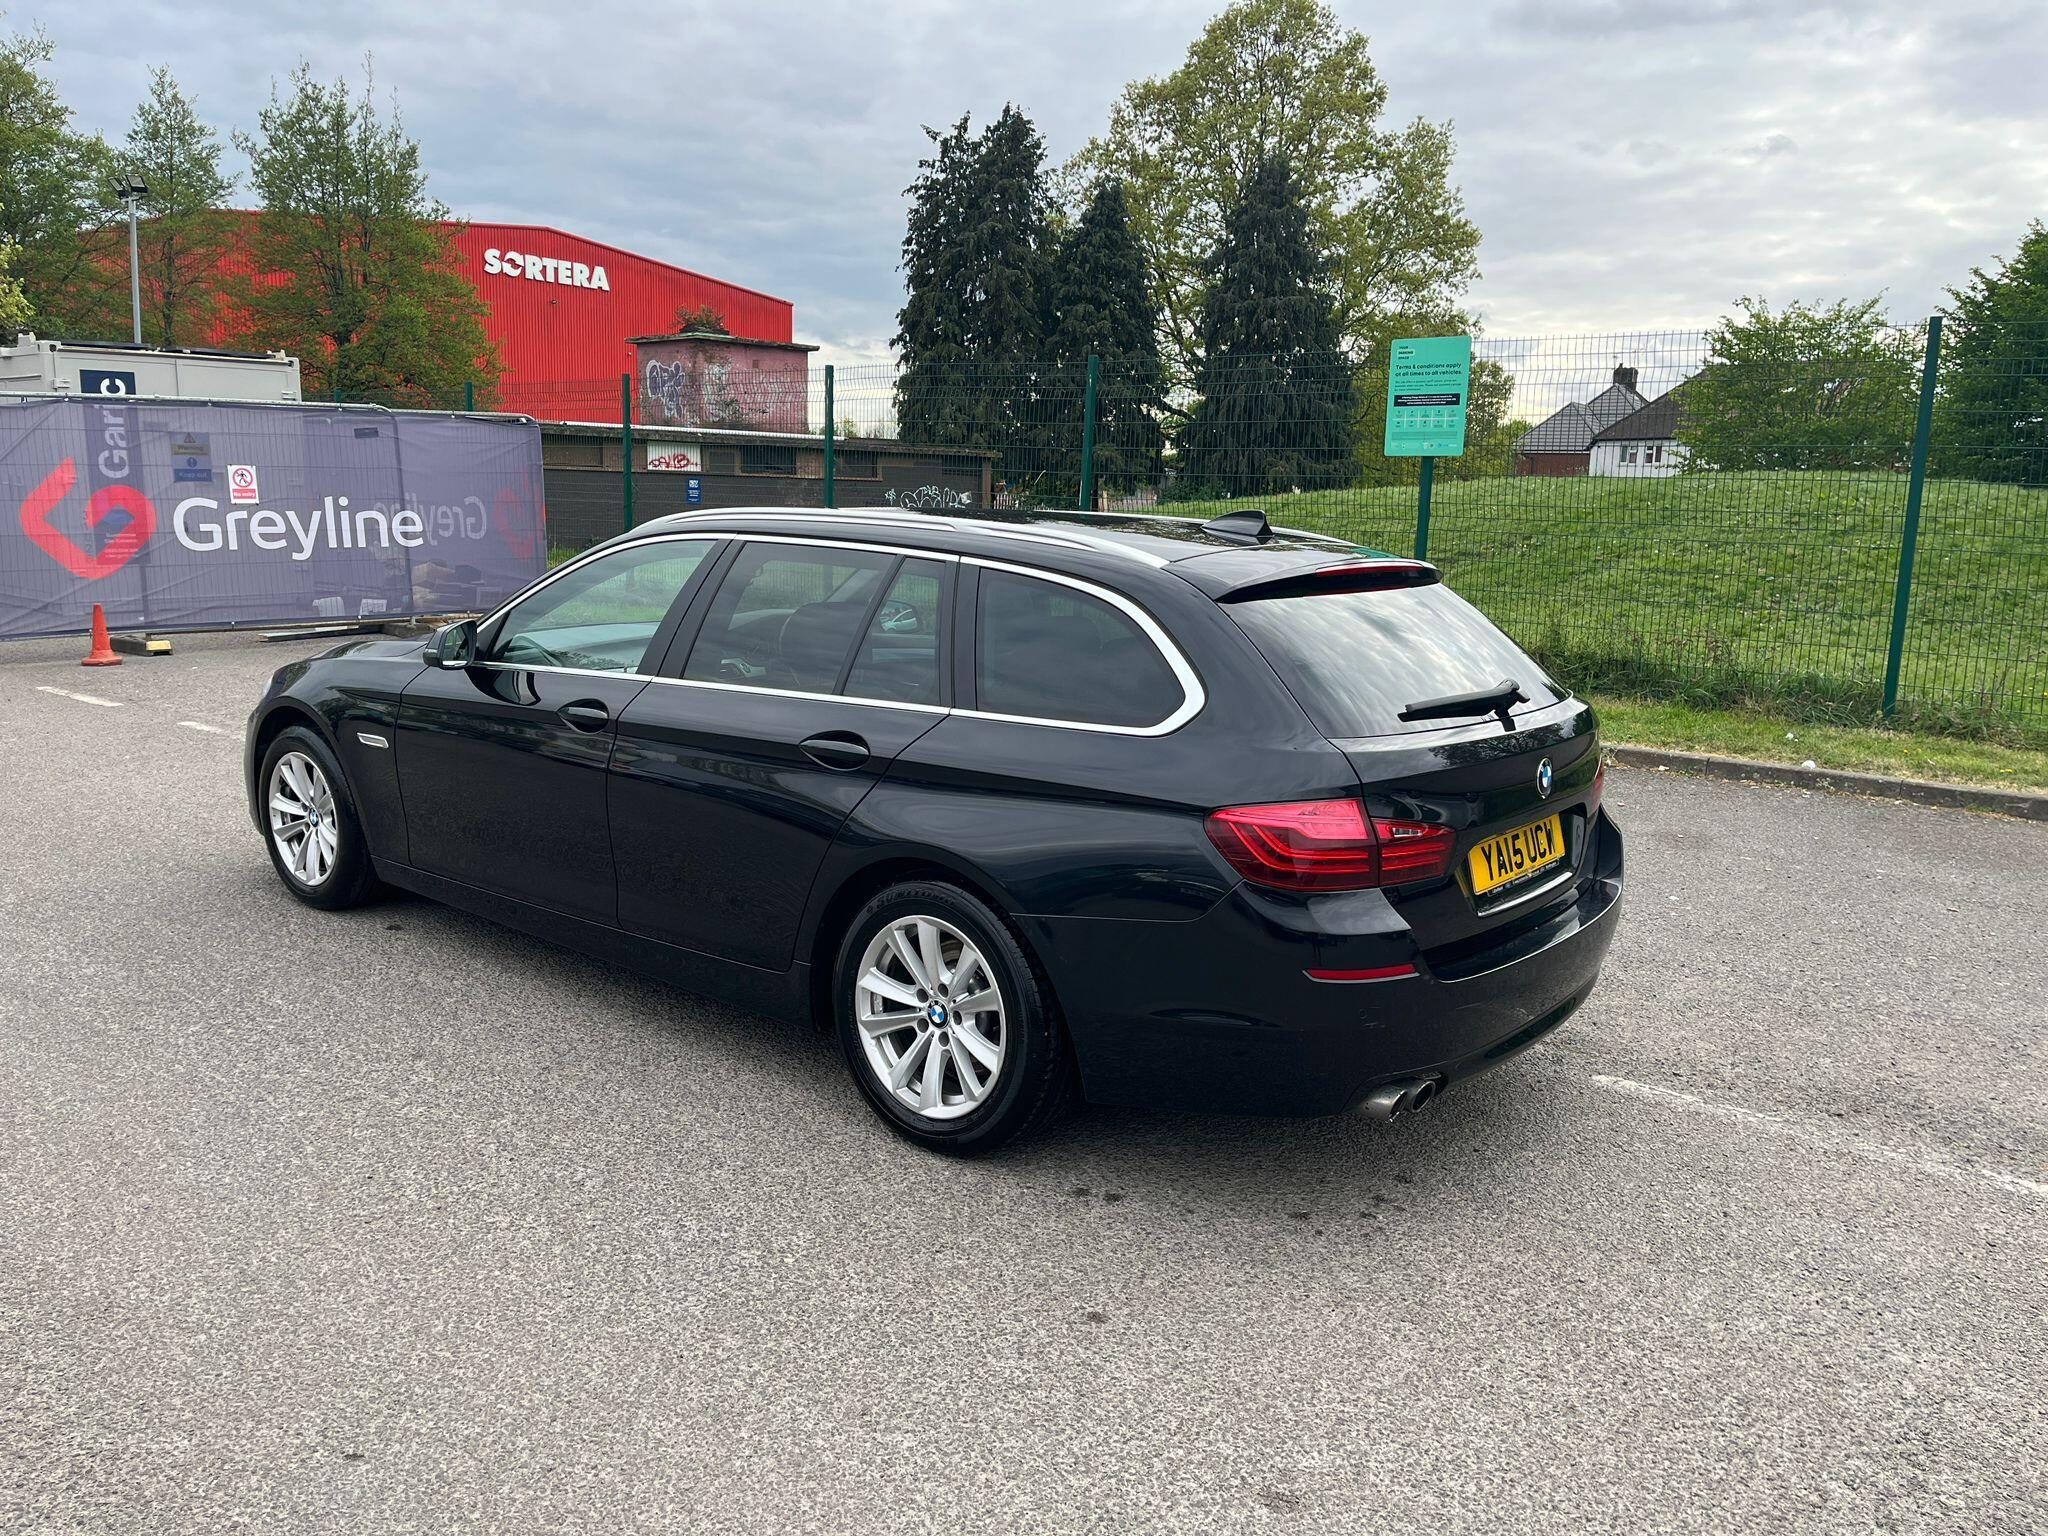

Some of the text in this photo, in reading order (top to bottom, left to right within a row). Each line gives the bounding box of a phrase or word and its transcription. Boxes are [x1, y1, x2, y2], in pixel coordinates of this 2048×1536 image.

[484, 248, 610, 291] SORTERA
[173, 496, 424, 561] Greyline
[1481, 833, 1525, 881] YA15
[1524, 819, 1556, 864] UCW
